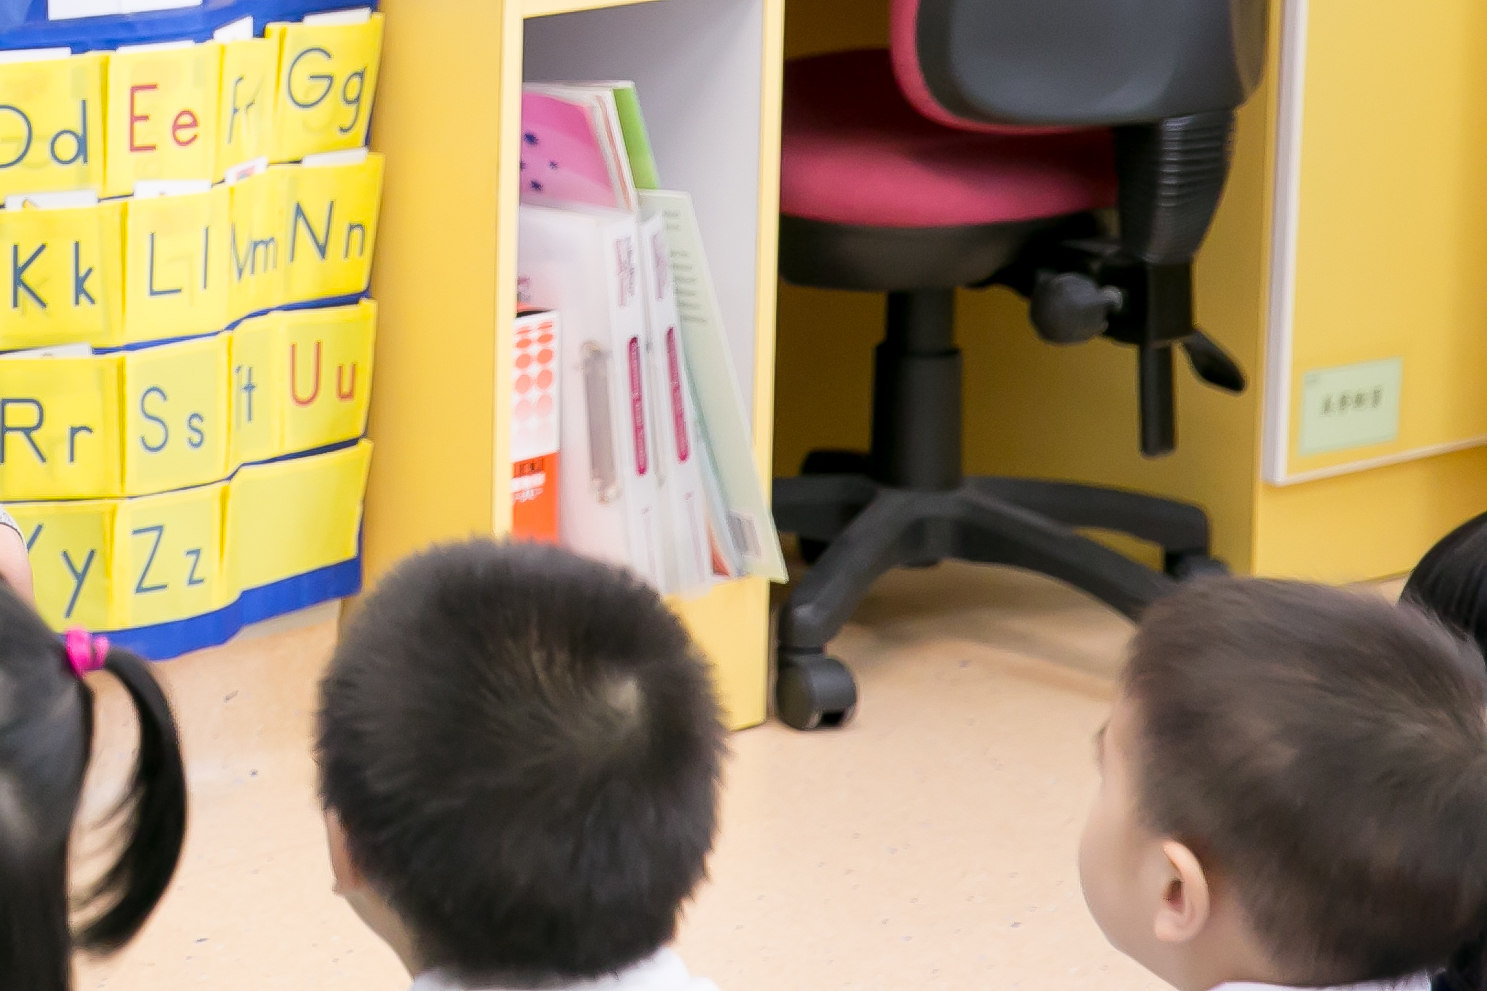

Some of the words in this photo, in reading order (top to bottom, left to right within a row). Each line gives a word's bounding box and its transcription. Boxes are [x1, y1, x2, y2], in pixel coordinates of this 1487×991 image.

[128, 83, 199, 153] Ee
[287, 46, 368, 134] Gg
[11, 240, 96, 310] Kk
[290, 199, 366, 264] Nn
[138, 384, 206, 453] Ss
[289, 339, 359, 407] Uu
[131, 525, 205, 594] Zz
